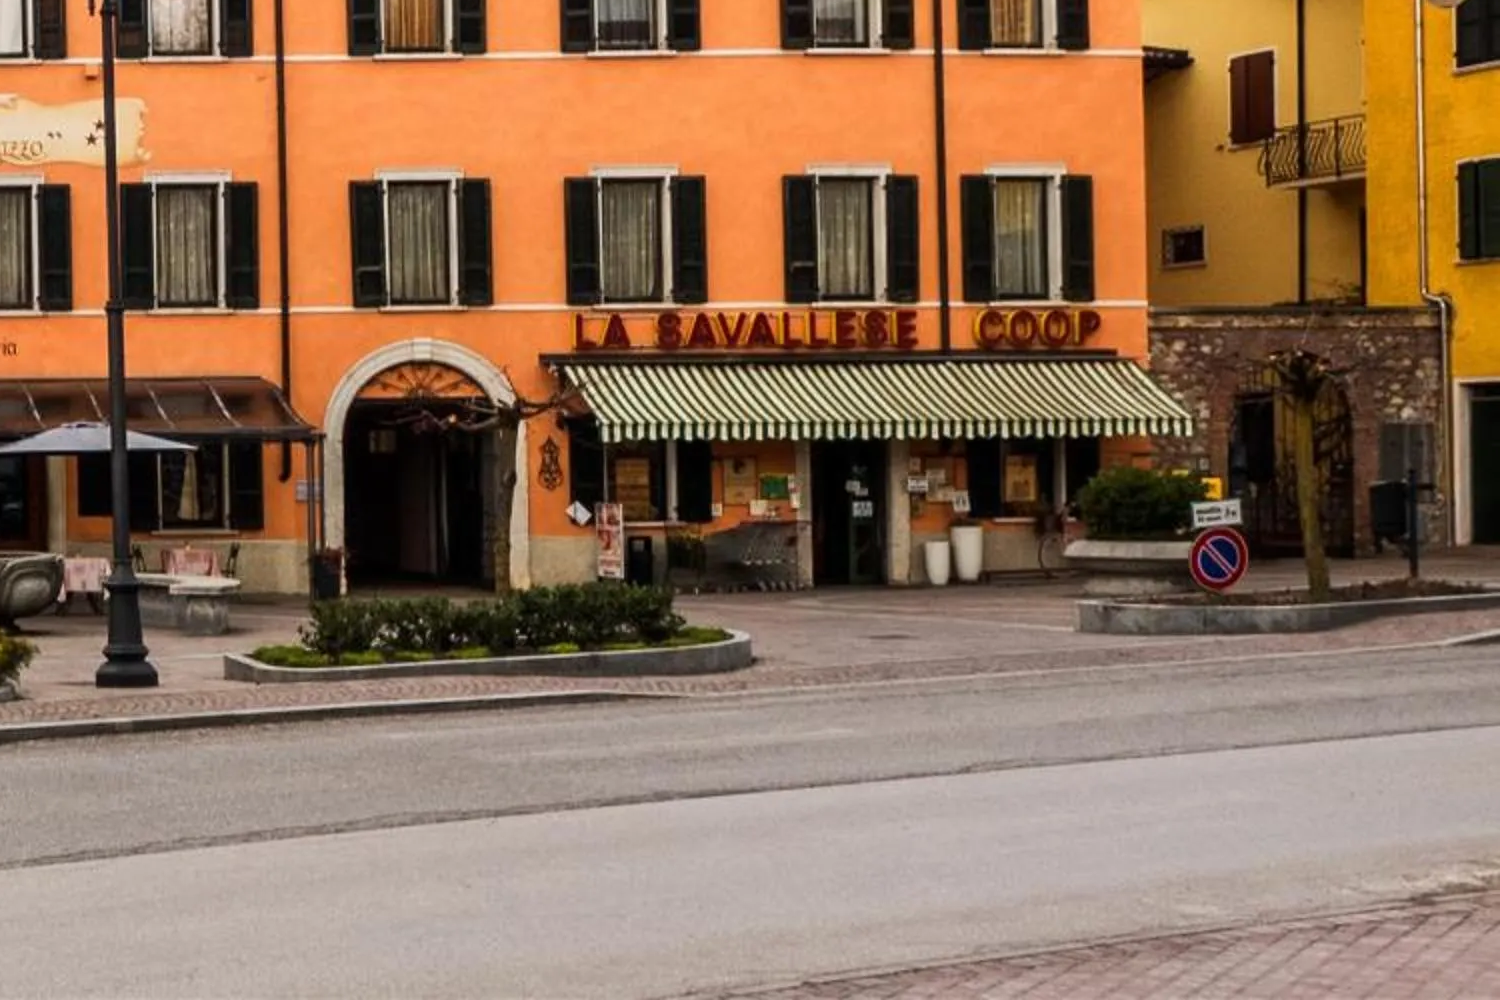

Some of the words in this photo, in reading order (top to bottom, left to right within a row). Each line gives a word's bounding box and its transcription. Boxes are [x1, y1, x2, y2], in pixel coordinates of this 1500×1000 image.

[572, 310, 632, 350] LA
[655, 309, 920, 350] SAVALLESE
[973, 308, 1102, 348] COOP
